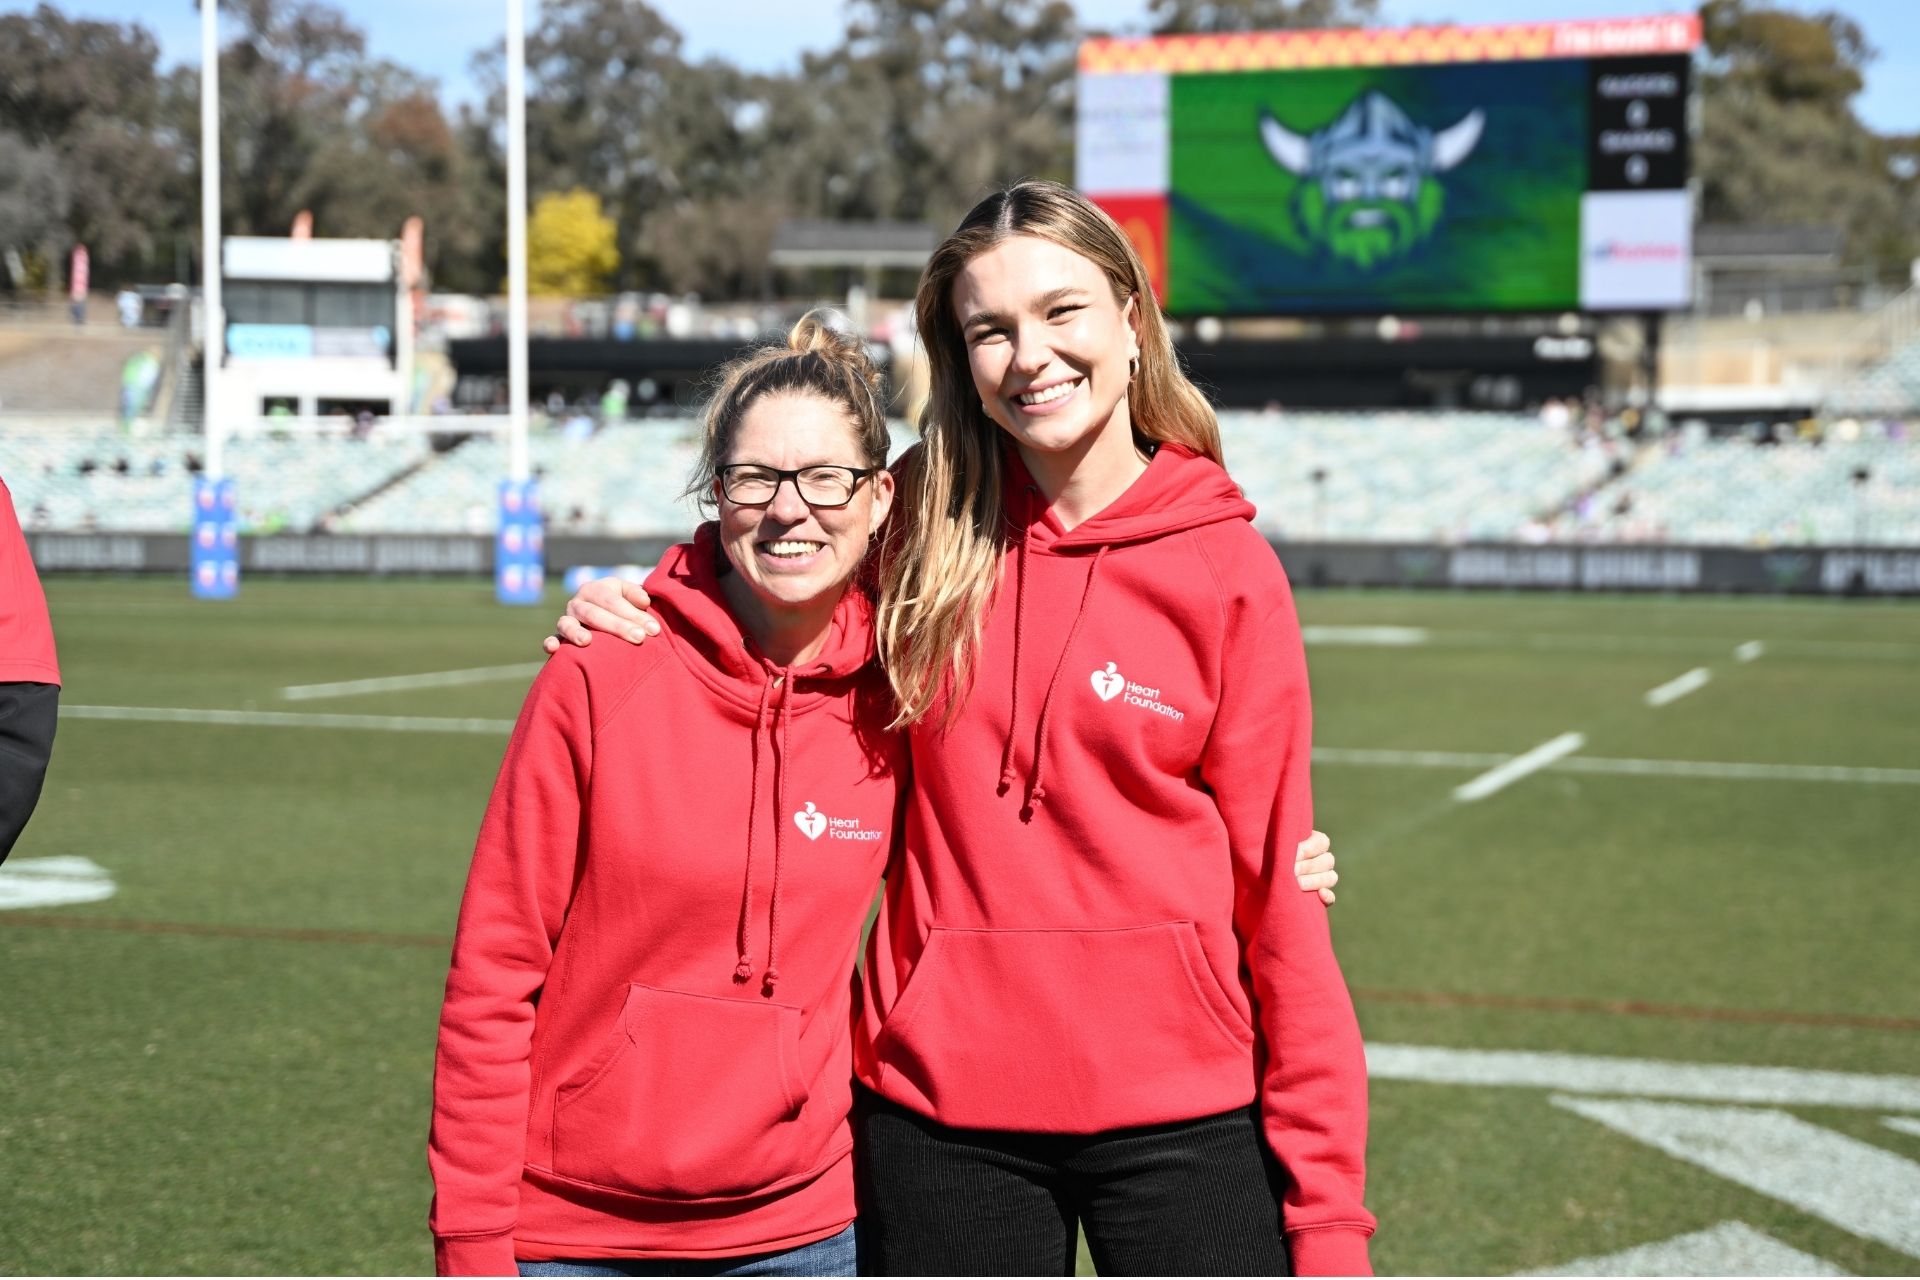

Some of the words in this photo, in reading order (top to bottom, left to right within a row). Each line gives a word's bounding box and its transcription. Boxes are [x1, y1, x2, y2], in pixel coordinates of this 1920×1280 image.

[1126, 680, 1161, 699] Heart
[1124, 692, 1185, 721] Foundation
[829, 816, 859, 829] Heart
[829, 828, 882, 841] Foundatio
